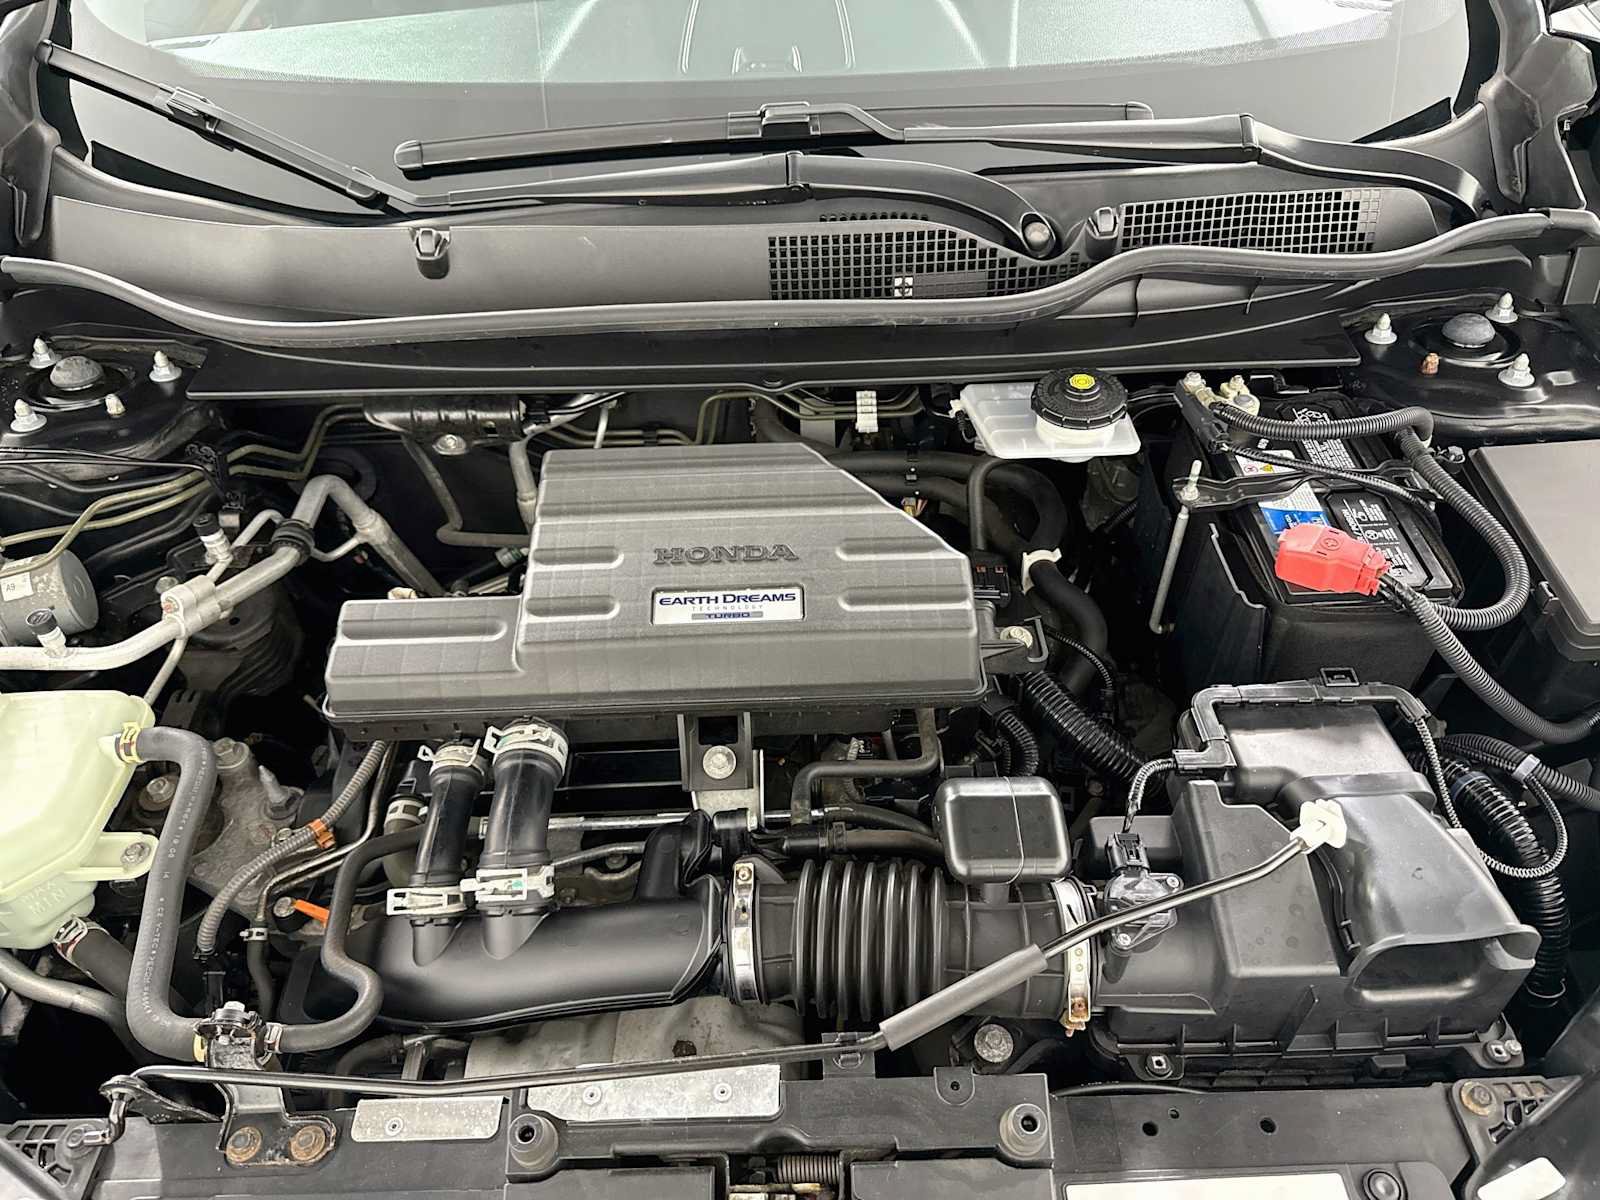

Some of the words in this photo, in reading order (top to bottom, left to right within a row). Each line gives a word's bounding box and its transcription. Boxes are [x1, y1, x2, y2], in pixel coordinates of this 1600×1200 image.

[653, 544, 800, 565] HONDA
[659, 596, 719, 606] EARTH
[722, 593, 796, 604] DREAMS
[28, 887, 66, 915] MIN
